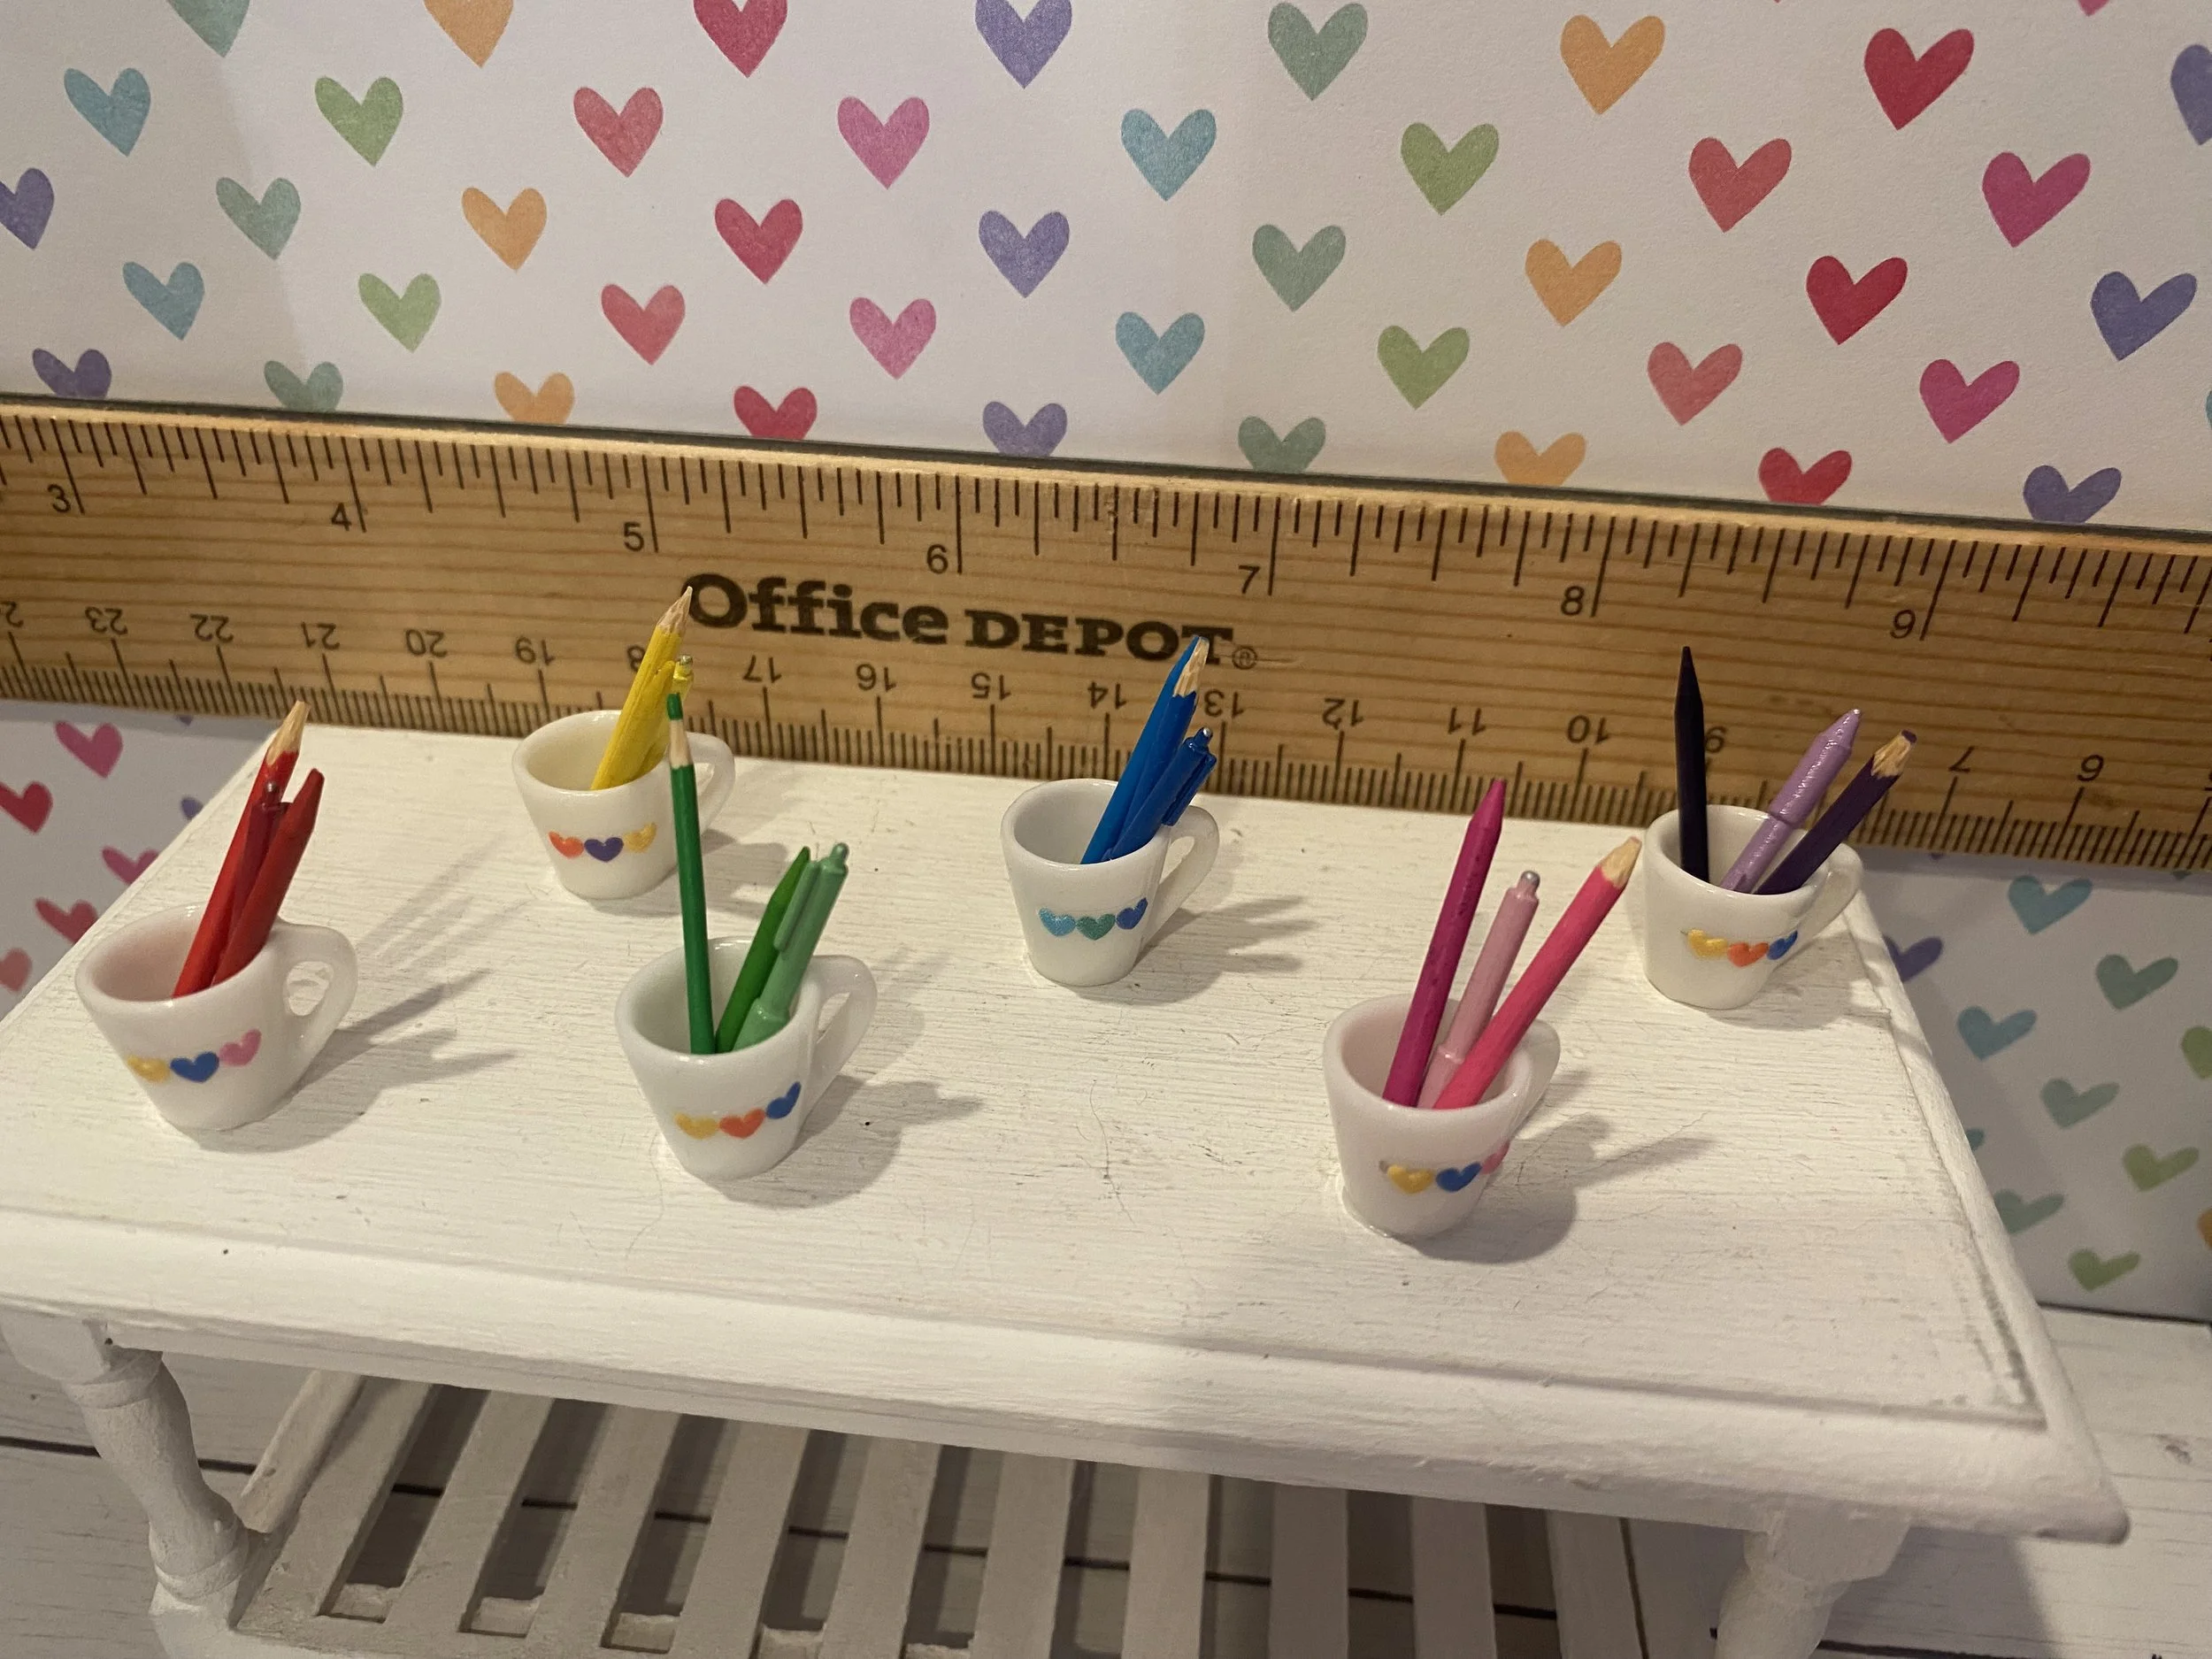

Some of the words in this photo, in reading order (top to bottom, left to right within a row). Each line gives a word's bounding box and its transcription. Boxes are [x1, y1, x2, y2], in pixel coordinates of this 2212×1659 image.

[47, 483, 72, 513] 3
[331, 502, 352, 531] 4
[622, 521, 645, 552] 5
[926, 543, 949, 574] 6
[1238, 565, 1261, 595] 7
[1560, 585, 1586, 616] 8
[1890, 609, 1916, 639] 9
[84, 606, 128, 635] 23
[189, 612, 234, 644] 22
[680, 572, 949, 646] Office
[964, 609, 1234, 666] DEPOT
[300, 621, 341, 651] 21
[404, 627, 449, 659] 20
[513, 634, 557, 667] 19
[742, 656, 783, 684] 17
[855, 663, 898, 693] 16
[971, 672, 1012, 701] 15
[1087, 681, 1128, 710] 14
[1203, 688, 1245, 718] 13
[1322, 696, 1366, 728] 12
[1447, 706, 1487, 736] 11
[1566, 715, 1611, 745] 10
[1948, 745, 1976, 774] 7
